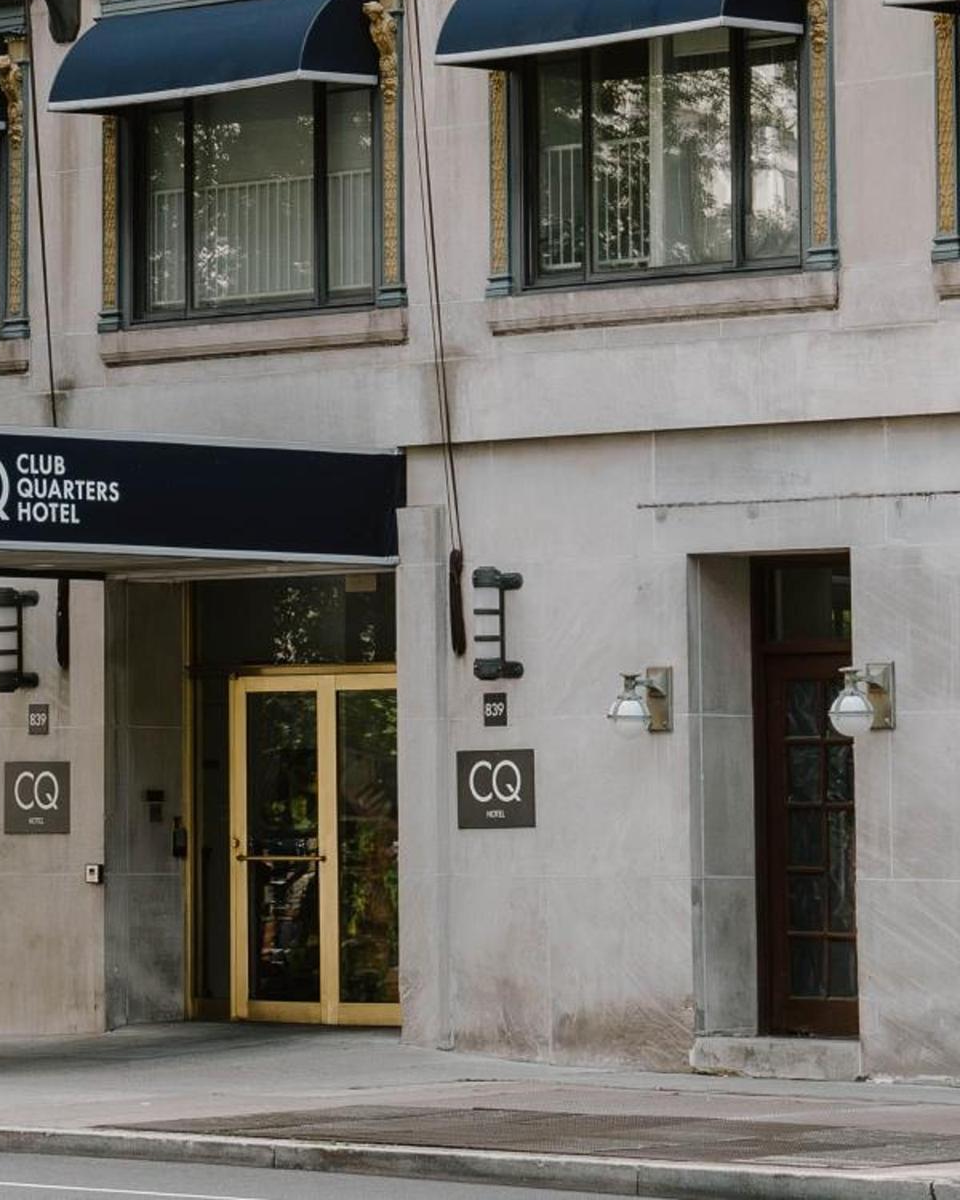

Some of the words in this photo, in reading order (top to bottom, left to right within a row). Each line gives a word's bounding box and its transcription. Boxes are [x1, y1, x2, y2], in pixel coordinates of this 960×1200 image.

[16, 453, 66, 475] CLUB
[16, 477, 120, 503] QUARTERS
[16, 502, 80, 524] HOTEL
[30, 712, 47, 727] 839
[485, 702, 505, 717] 839
[14, 770, 59, 811] CQ
[468, 759, 522, 803] CQ
